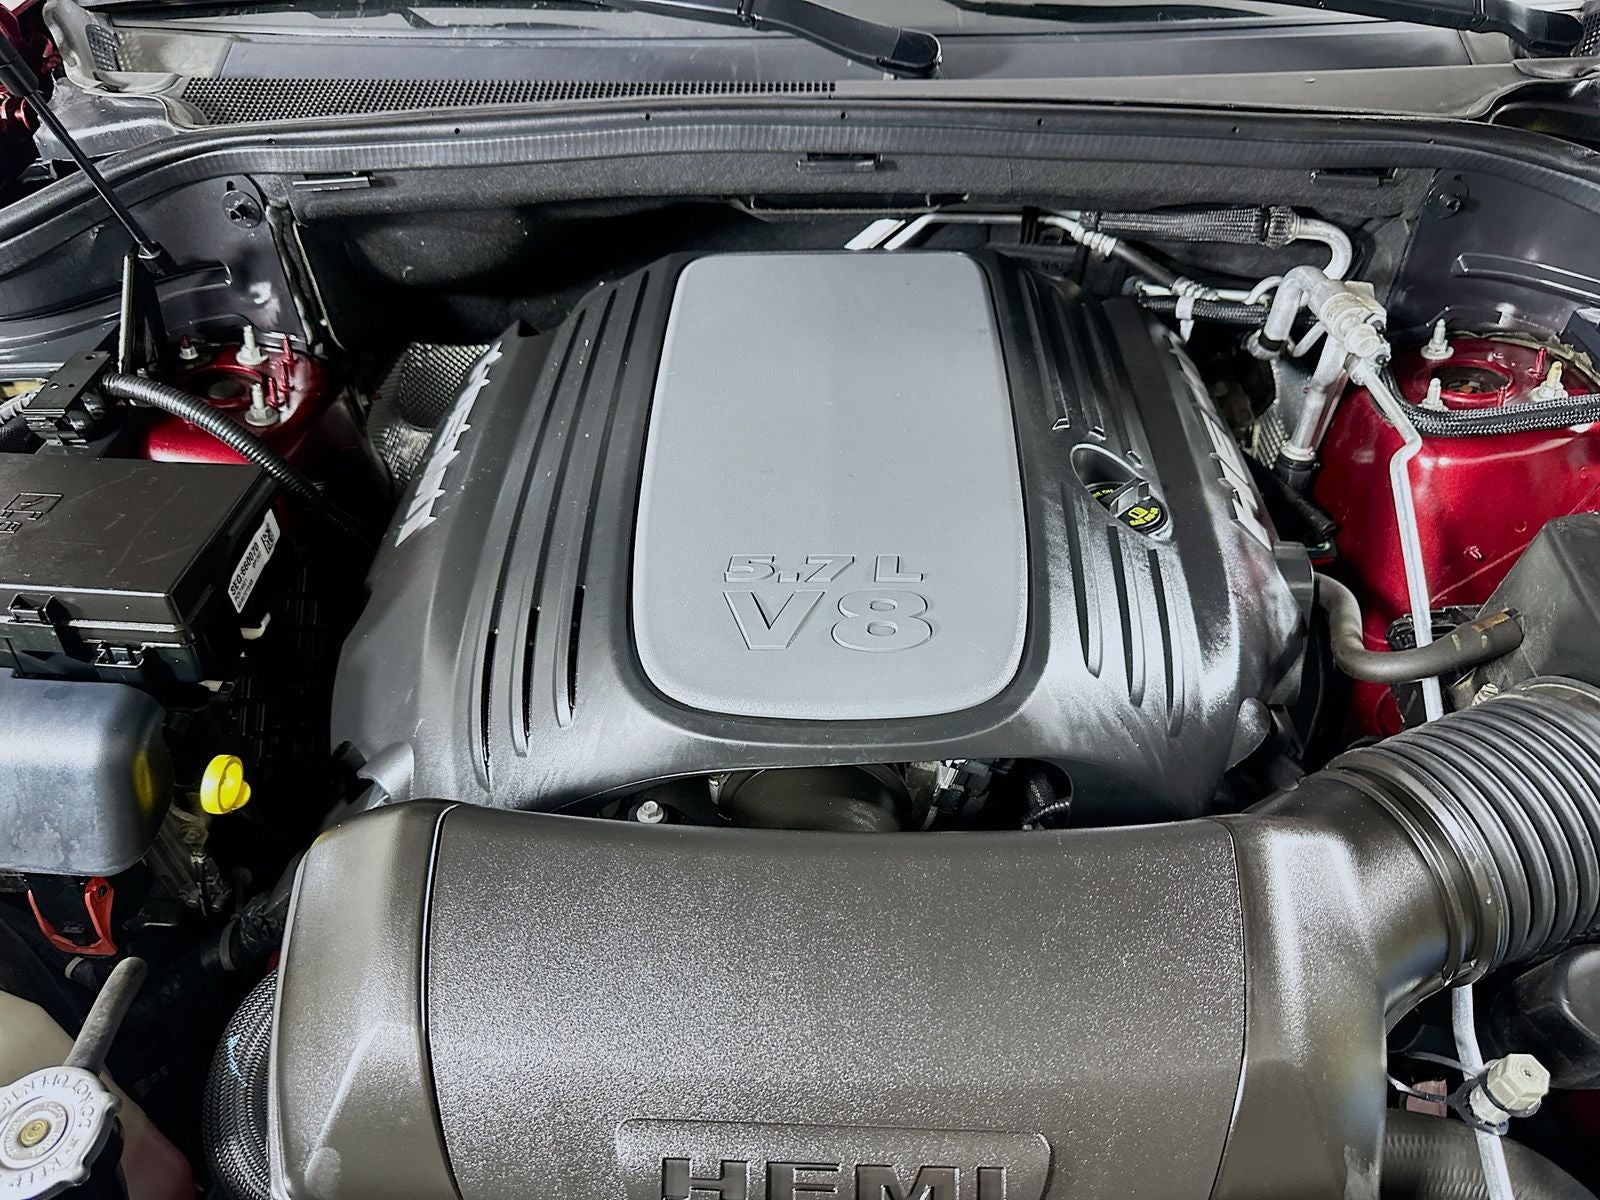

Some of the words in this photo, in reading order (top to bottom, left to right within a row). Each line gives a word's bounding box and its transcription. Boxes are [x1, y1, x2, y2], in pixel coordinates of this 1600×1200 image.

[724, 554, 856, 583] 5.7
[874, 554, 924, 583] L
[722, 588, 934, 653] V8
[662, 1157, 1006, 1200] HEMI
